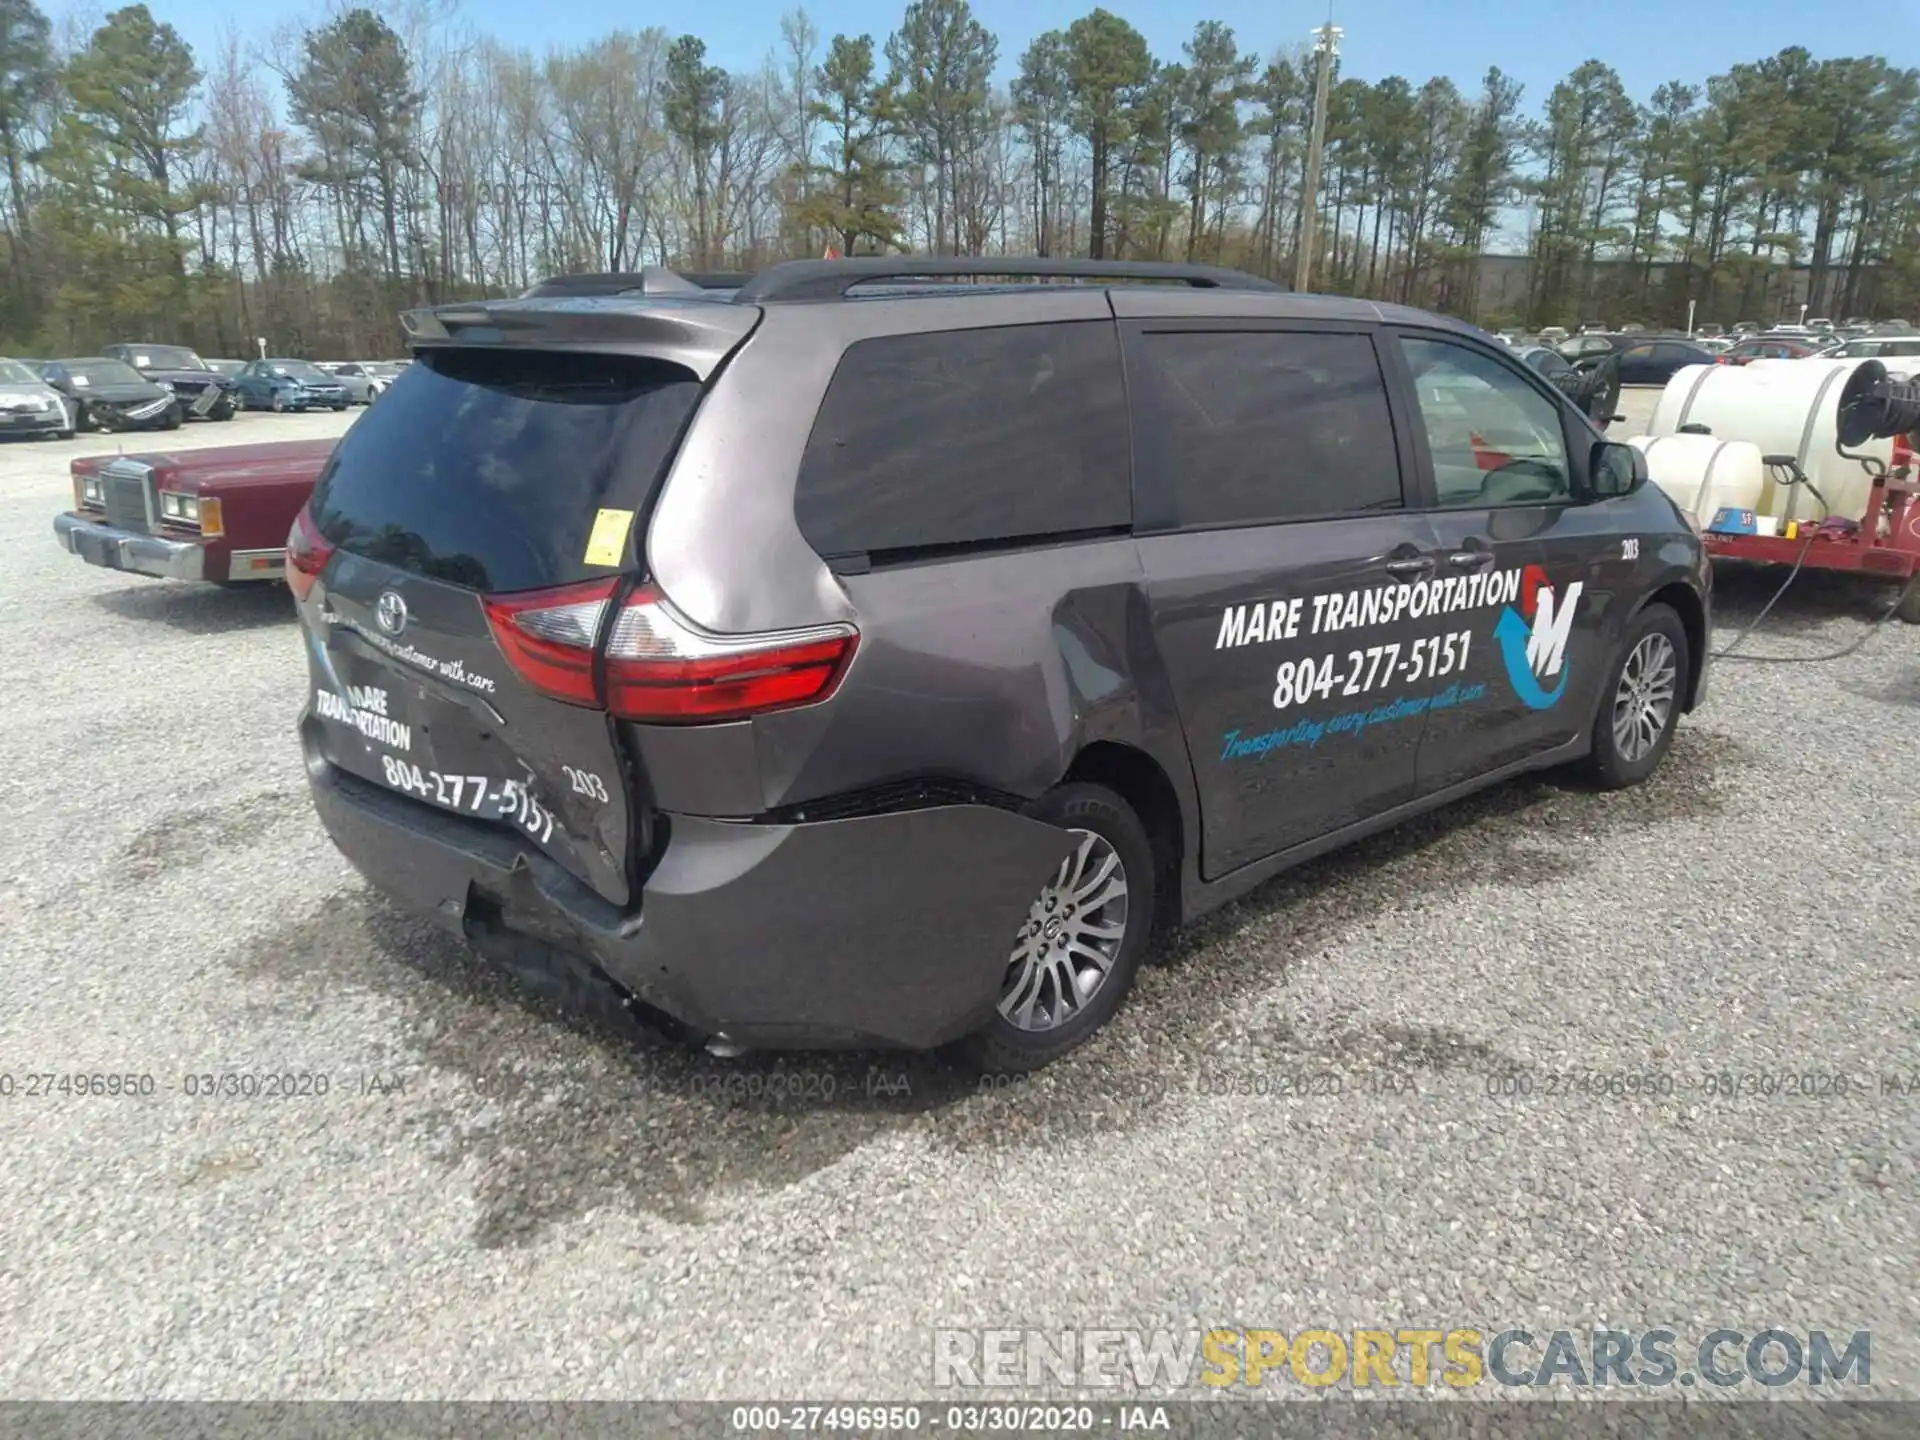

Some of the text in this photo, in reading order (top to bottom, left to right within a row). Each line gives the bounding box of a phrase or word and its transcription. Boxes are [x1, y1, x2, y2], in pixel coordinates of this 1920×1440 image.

[1621, 538, 1639, 560] 203
[1215, 567, 1523, 649] MARE TRANSPORTATION
[440, 659, 466, 683] with
[467, 672, 496, 694] care
[1273, 630, 1473, 709] 804-277-5151
[562, 765, 609, 803] 203
